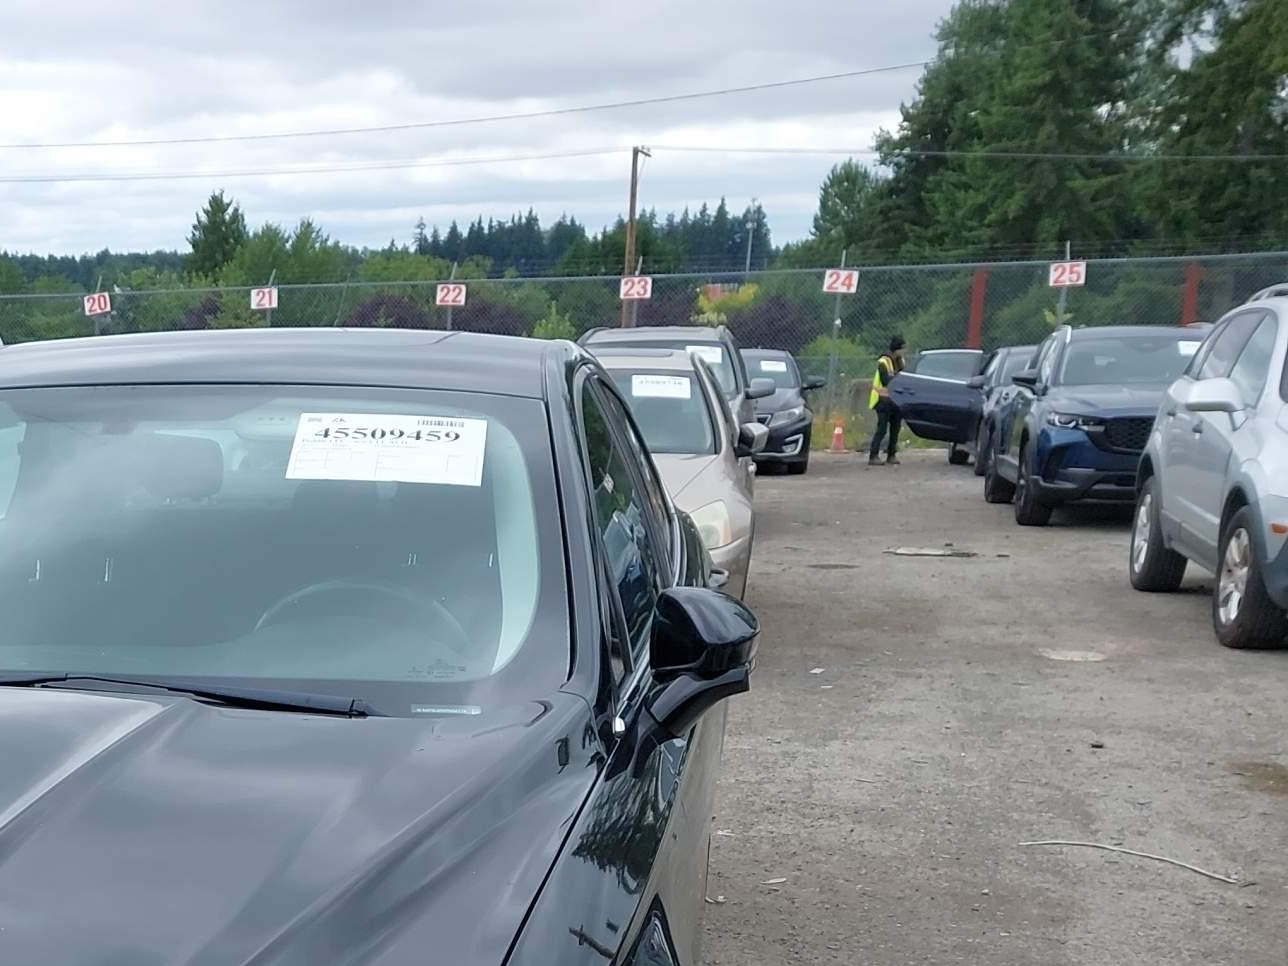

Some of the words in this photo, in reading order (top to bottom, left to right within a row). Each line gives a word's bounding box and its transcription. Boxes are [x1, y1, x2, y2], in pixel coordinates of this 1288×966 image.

[825, 270, 854, 291] 24
[1052, 264, 1082, 284] 25
[255, 289, 273, 307] 21
[439, 286, 462, 304] 22
[623, 279, 649, 298] 23
[86, 294, 108, 313] 20
[314, 426, 461, 443] 45509459
